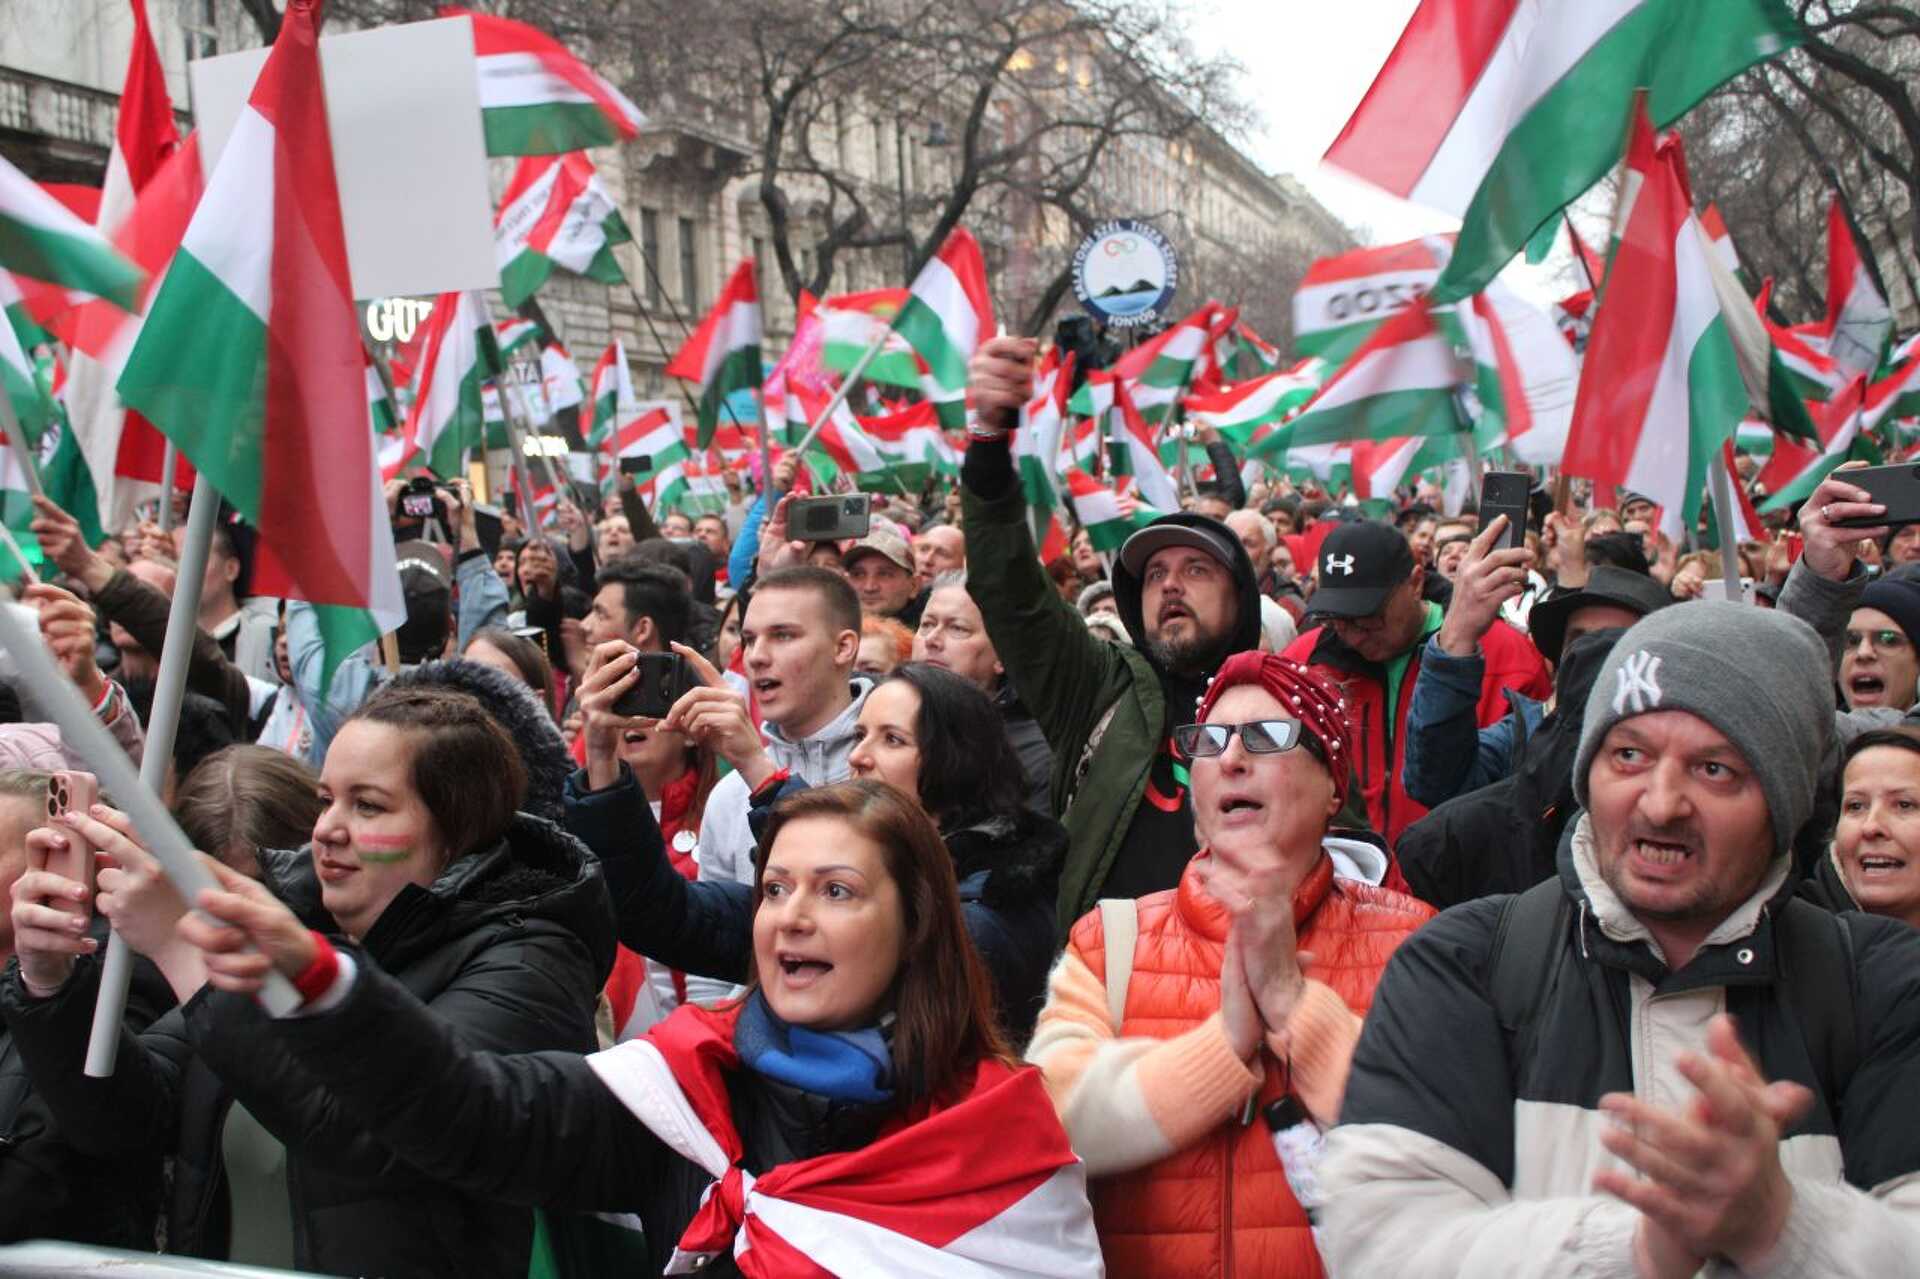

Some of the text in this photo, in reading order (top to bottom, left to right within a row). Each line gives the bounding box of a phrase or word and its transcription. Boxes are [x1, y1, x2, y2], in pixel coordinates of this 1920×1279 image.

[1072, 236, 1095, 302] BALATONI
[1131, 221, 1163, 245] TISZA
[1160, 243, 1177, 289] SZIGET
[1612, 649, 1662, 715] NY
